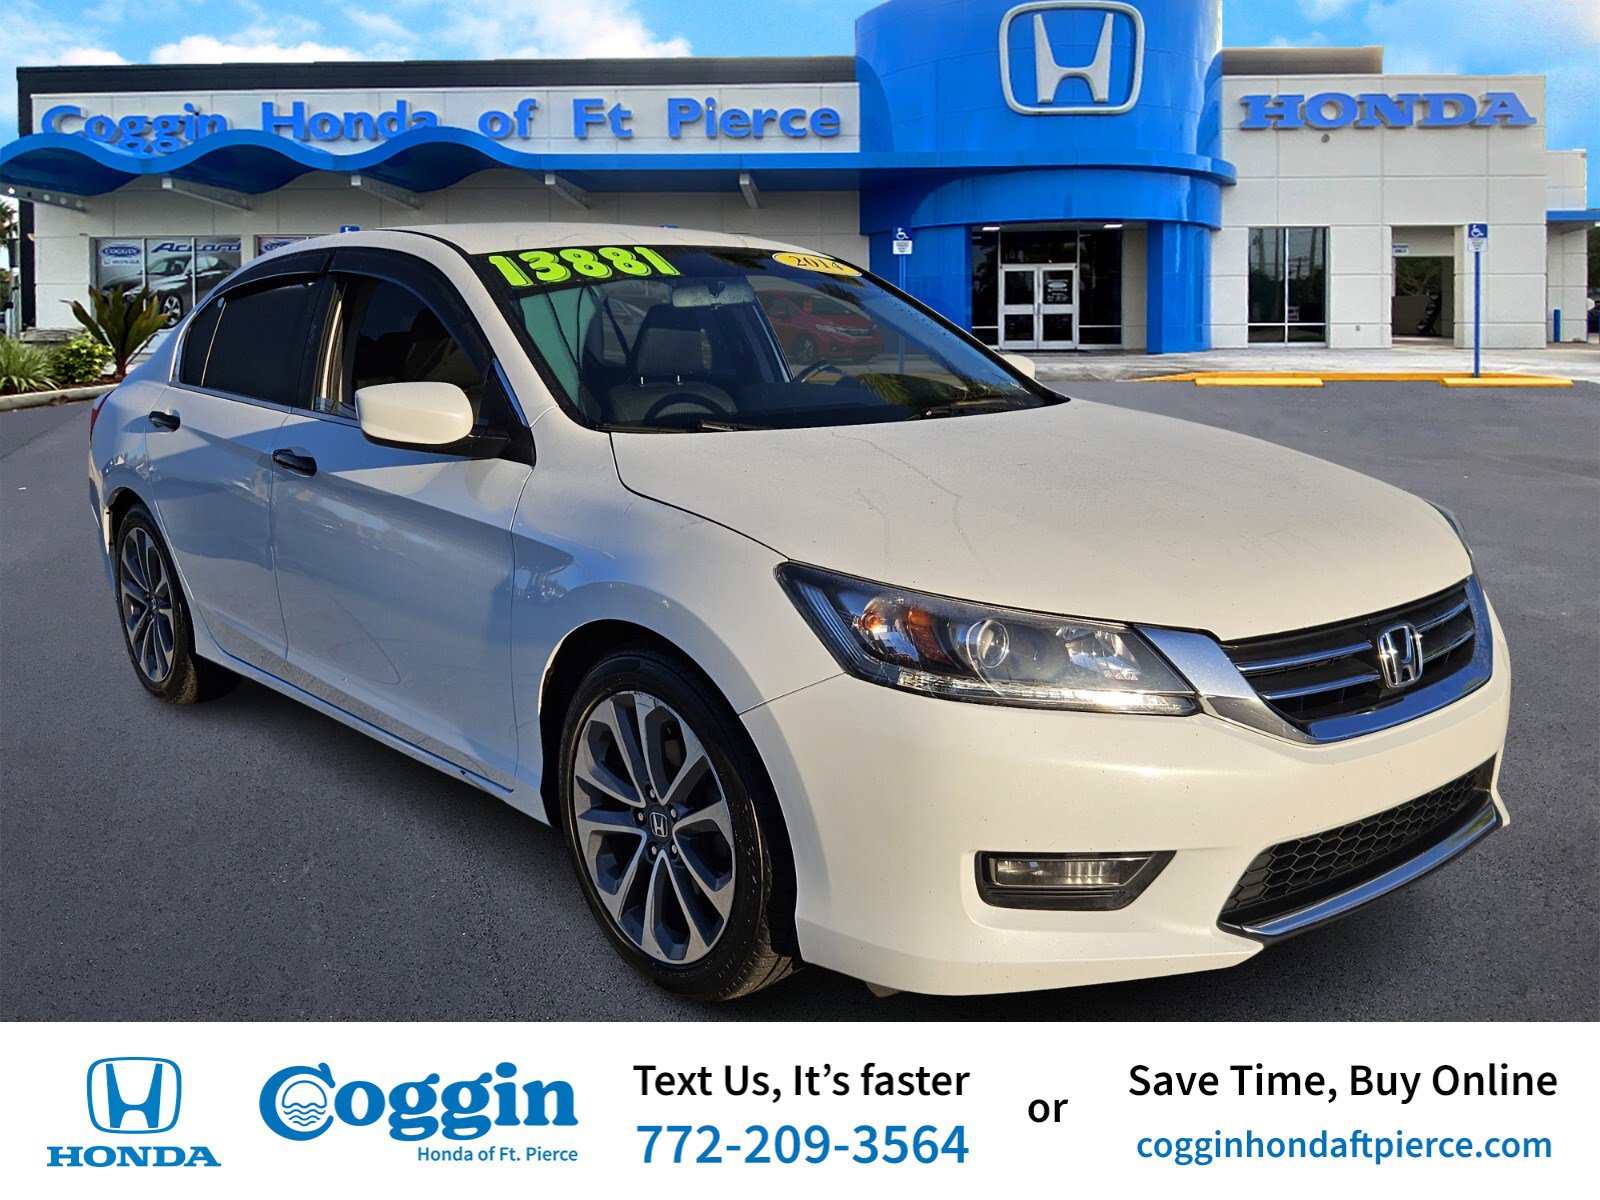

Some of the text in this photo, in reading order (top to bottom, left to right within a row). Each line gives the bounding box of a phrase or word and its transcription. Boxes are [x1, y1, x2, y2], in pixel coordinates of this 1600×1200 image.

[41, 97, 841, 154] Coggin Honda of Ft Pierce
[1240, 92, 1537, 129] HONDA
[489, 246, 682, 288] 13881
[788, 255, 844, 271] 2014
